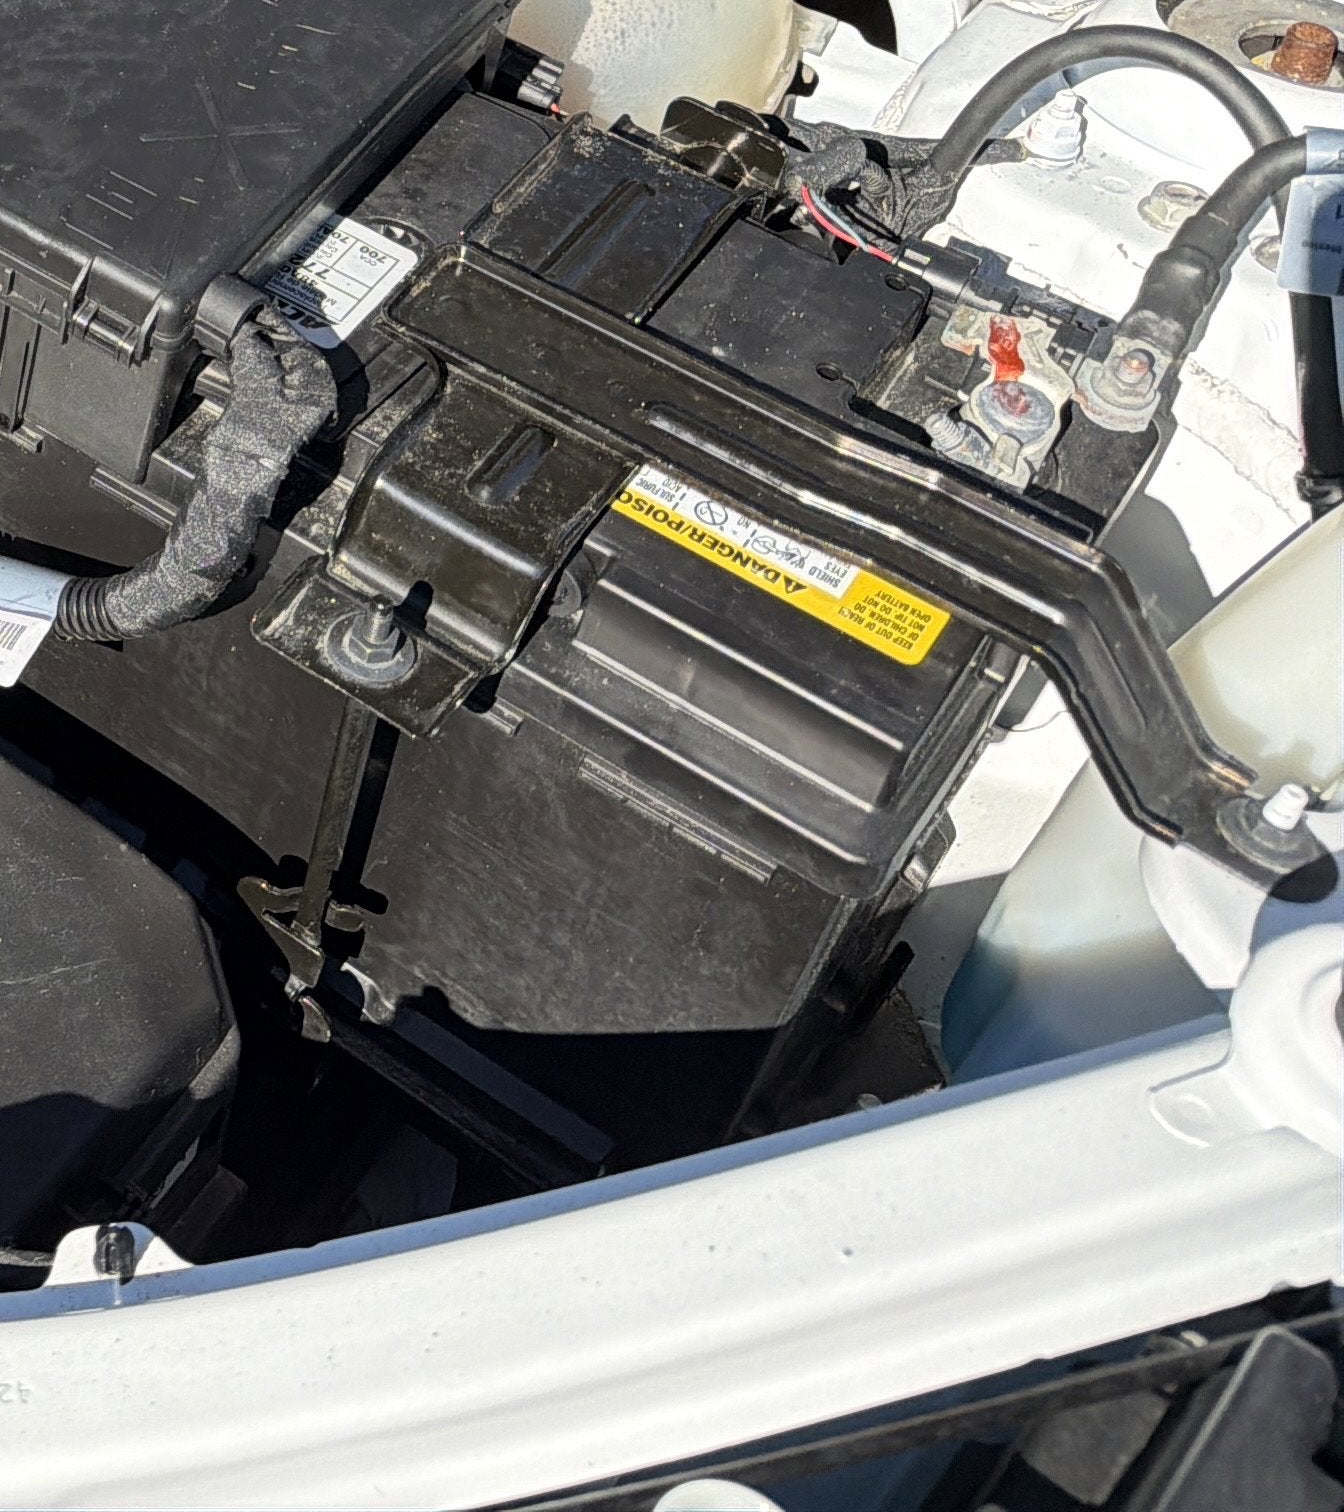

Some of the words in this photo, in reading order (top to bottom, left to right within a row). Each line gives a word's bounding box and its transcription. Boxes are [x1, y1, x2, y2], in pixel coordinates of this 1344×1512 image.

[359, 245, 387, 265] 700
[636, 478, 675, 503] SULFURIC
[663, 477, 683, 492] ACID
[618, 491, 782, 584] DANGER/POISO
[808, 566, 841, 589] SHIELD
[824, 562, 849, 579] EYES
[853, 602, 867, 613] DO
[862, 595, 880, 609] NOT
[874, 590, 911, 613] BATTERY
[837, 606, 863, 626] REACH
[878, 605, 893, 616] DO
[909, 608, 932, 624] OPEN
[863, 621, 877, 632] OF
[875, 626, 894, 639] OUT
[908, 620, 926, 633] NOT
[893, 636, 914, 651] KEEP
[907, 631, 921, 642] OF
